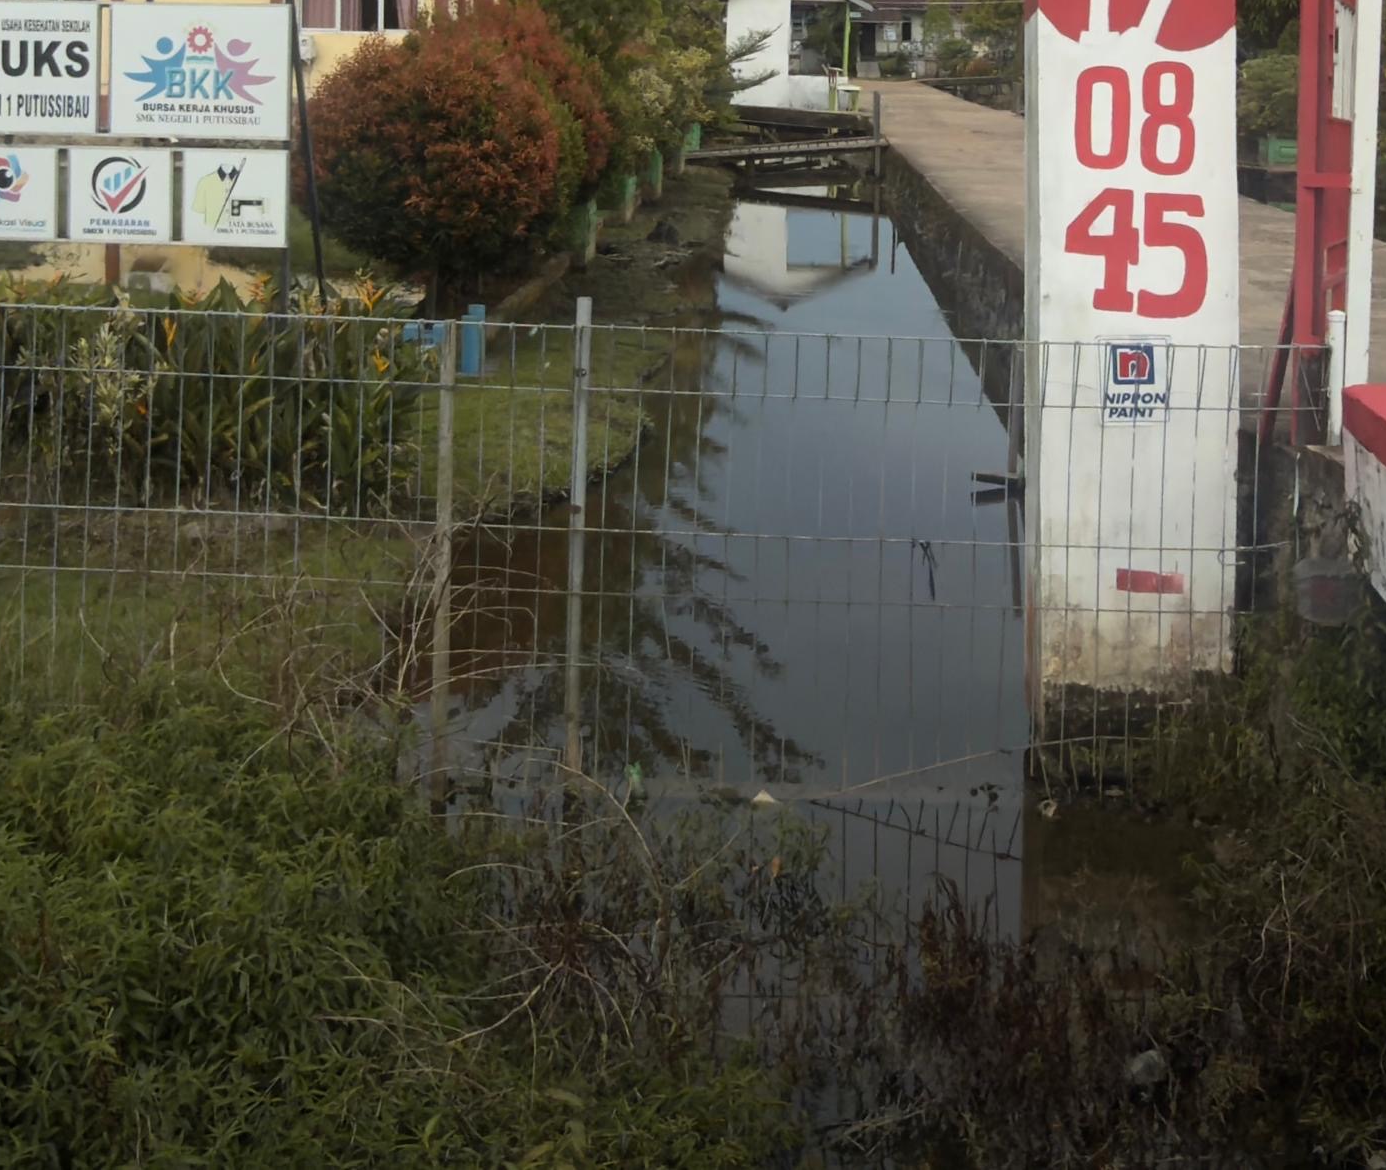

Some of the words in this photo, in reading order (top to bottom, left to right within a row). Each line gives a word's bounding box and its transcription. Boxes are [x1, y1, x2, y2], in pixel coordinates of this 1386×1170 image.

[1, 18, 23, 31] USAHA
[24, 19, 60, 32] KESEHATAN
[61, 20, 91, 33] SEKOLAH
[1, 40, 90, 78] UKS
[165, 67, 235, 100] BKK
[6, 94, 12, 117] 1
[17, 94, 90, 119] PUTUSSIBAU
[143, 102, 176, 112] BURSA
[179, 103, 211, 113] KERJA
[213, 104, 255, 114] KHUSUS
[136, 113, 155, 123] SMK
[158, 114, 192, 124] NEGERI
[203, 115, 261, 126] PUTUSSIBAU
[1074, 61, 1196, 177] 08
[1064, 187, 1209, 319] 45
[1105, 392, 1167, 405] NIPPON
[1108, 407, 1155, 418] PAINT
